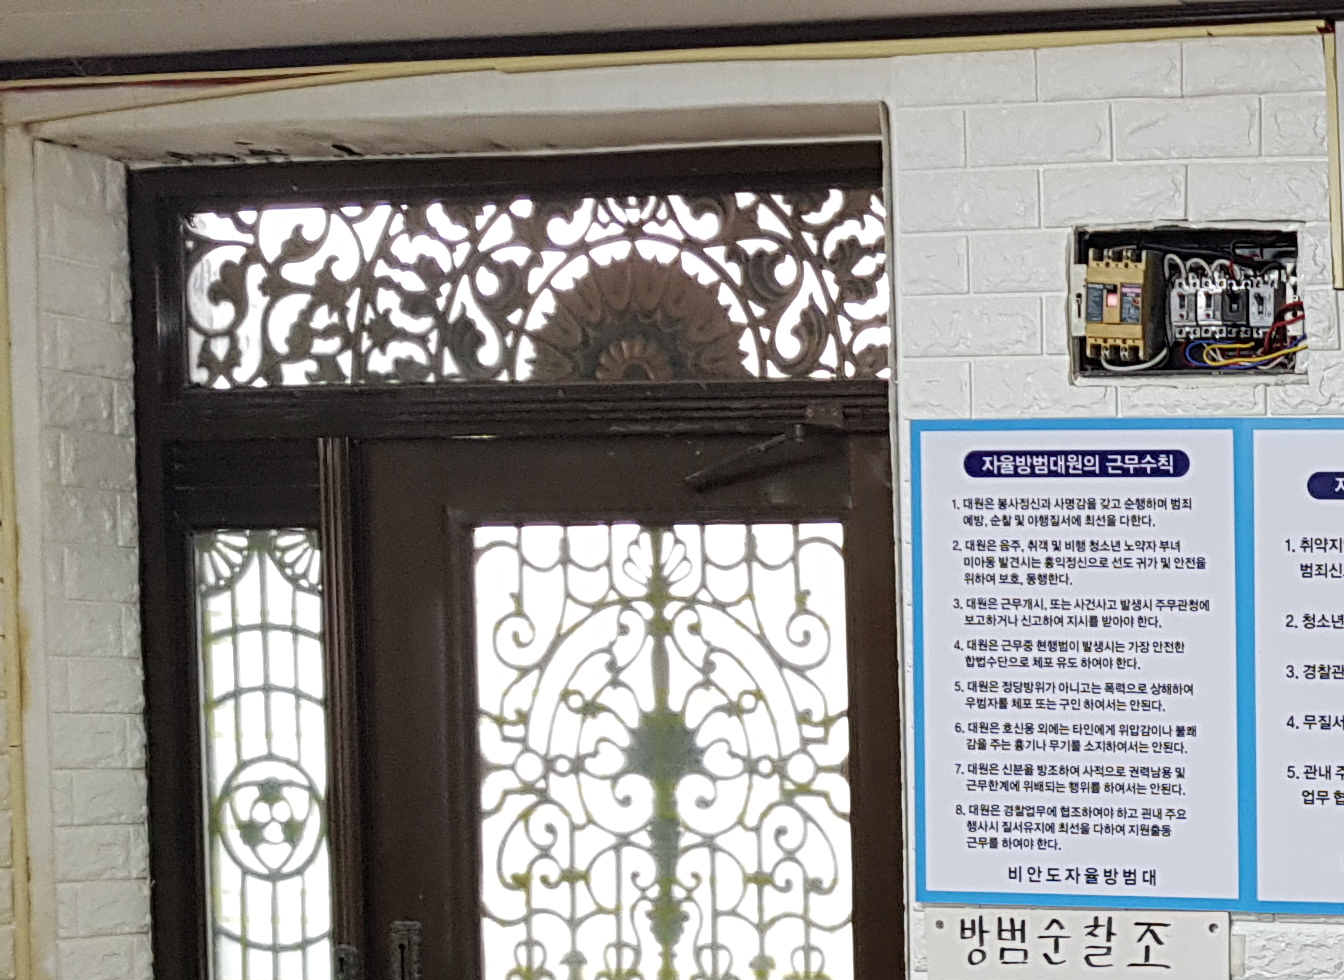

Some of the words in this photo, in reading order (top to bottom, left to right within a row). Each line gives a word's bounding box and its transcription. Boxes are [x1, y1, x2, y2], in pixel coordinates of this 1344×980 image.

[982, 454, 1099, 474] 자율방범대원의
[1106, 454, 1173, 473] 근무수칙
[952, 499, 959, 509] 1.
[963, 497, 994, 509] 대원은
[1170, 498, 1191, 509] 범죄
[1120, 514, 1155, 526] 다한다.
[952, 540, 961, 550] 2.
[965, 539, 996, 551] 대원은
[1285, 538, 1295, 552] 1.
[1112, 557, 1133, 568] 선도
[964, 573, 995, 584] 위하여
[953, 598, 962, 609] 3.
[966, 597, 998, 609] 대원은
[1074, 598, 1117, 610] 사건사고
[964, 614, 1018, 626] 보고하거나
[1021, 615, 1063, 626] 신고하여
[1102, 615, 1134, 627] 받아야
[1137, 615, 1161, 627] 한다.
[1286, 614, 1297, 628] 2.
[1302, 613, 1344, 629] 청소년
[954, 640, 963, 650] 4.
[966, 638, 998, 651] 대원은
[1128, 641, 1149, 653] 가장
[1152, 640, 1184, 653] 안전한
[1056, 656, 1078, 668] 유도
[1080, 657, 1113, 668] 하여야
[1116, 657, 1140, 669] 한다.
[1286, 664, 1298, 678] 3.
[954, 681, 964, 691] 5.
[967, 680, 998, 692] 대원은
[1058, 681, 1101, 694] 아니고는
[1150, 683, 1193, 695] 상해하여
[1059, 698, 1080, 710] 구인
[1083, 698, 1126, 710] 하여서는
[1130, 699, 1165, 711] 안된다.
[954, 722, 964, 732] 6.
[968, 721, 999, 733] 대원은
[1002, 722, 1034, 734] 호신용
[1072, 723, 1115, 735] 타인에게
[1118, 724, 1172, 736] 위압감이나
[1286, 715, 1299, 728] 4.
[1303, 714, 1344, 730] 무질서
[990, 738, 1011, 750] 주는
[1084, 740, 1148, 752] 소지하여서는
[1152, 741, 1187, 753] 안된다.
[955, 763, 964, 774] 7.
[967, 762, 999, 775] 대원은
[1082, 765, 1126, 777] 사적으로
[1287, 765, 1299, 778] 5.
[1303, 764, 1331, 779] 관내
[966, 779, 1019, 791] 근무한계에
[1104, 782, 1146, 794] 하여서는
[1150, 783, 1185, 795] 안된다.
[1302, 789, 1330, 804] 업무
[955, 804, 965, 814] 8.
[968, 803, 1000, 816] 대원은
[1117, 807, 1138, 818] 하고
[1165, 808, 1186, 819] 주요
[1002, 821, 1054, 833] 질서유지에
[1093, 823, 1125, 835] 다하여
[1002, 837, 1034, 849] 하여야
[1037, 838, 1061, 850] 한다.
